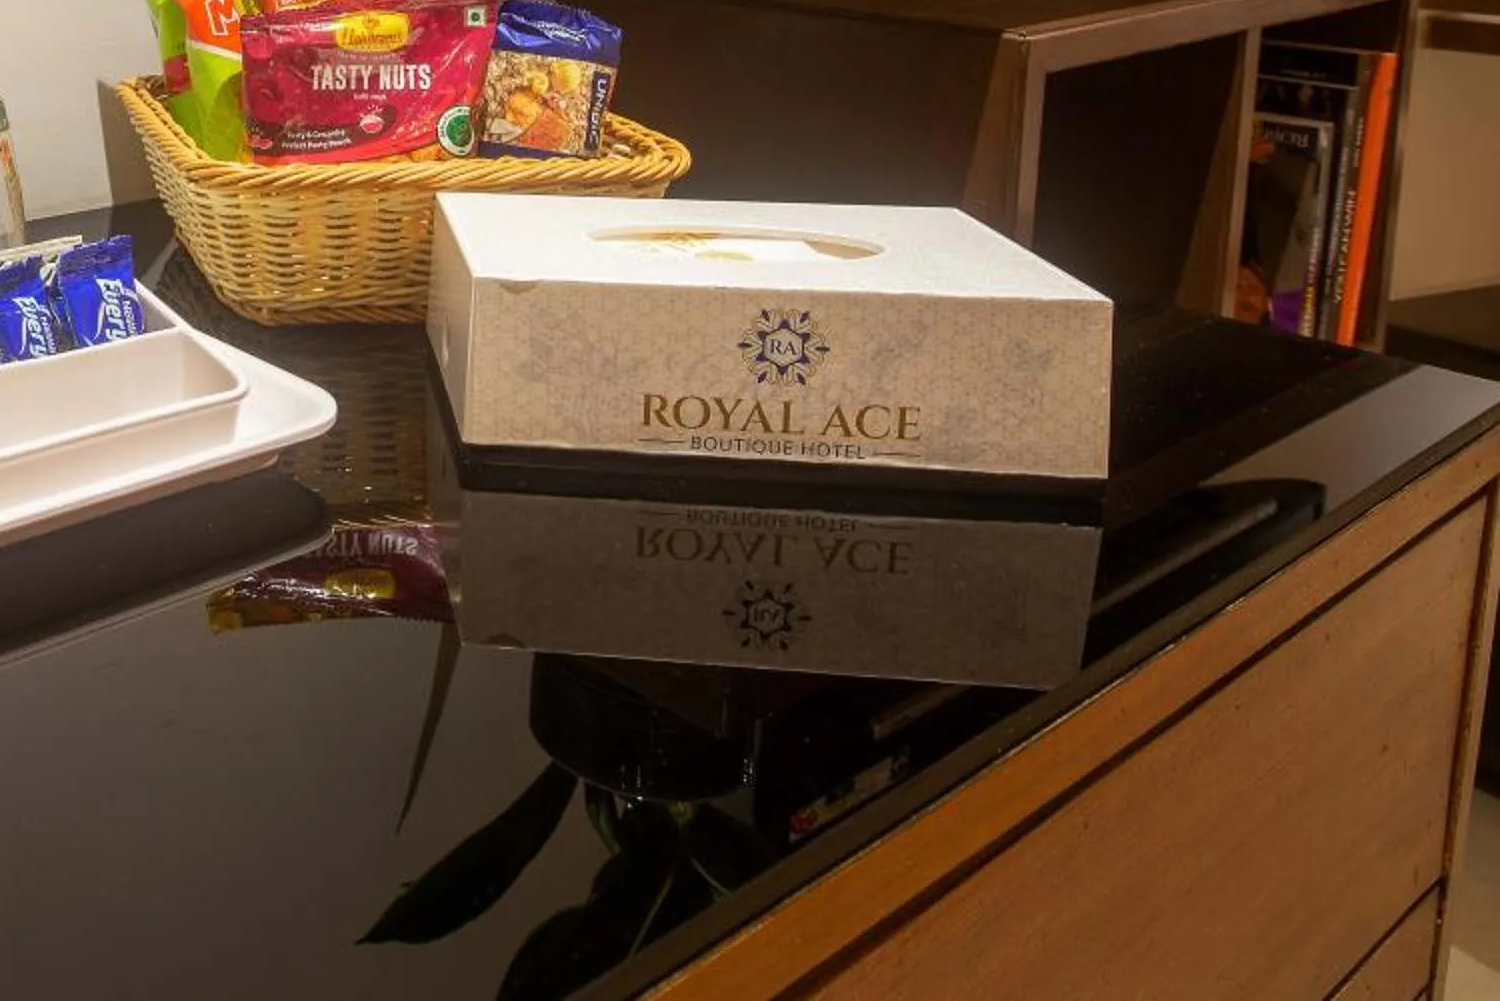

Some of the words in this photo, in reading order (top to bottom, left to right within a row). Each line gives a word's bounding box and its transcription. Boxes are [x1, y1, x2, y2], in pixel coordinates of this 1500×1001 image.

[310, 65, 375, 91] TASTY
[378, 64, 432, 91] NUTS
[769, 338, 798, 355] RA
[641, 394, 805, 435] ROYAL
[819, 403, 922, 441] ACE
[690, 435, 794, 456] BOUTIQUE
[800, 441, 866, 460] HOTEL
